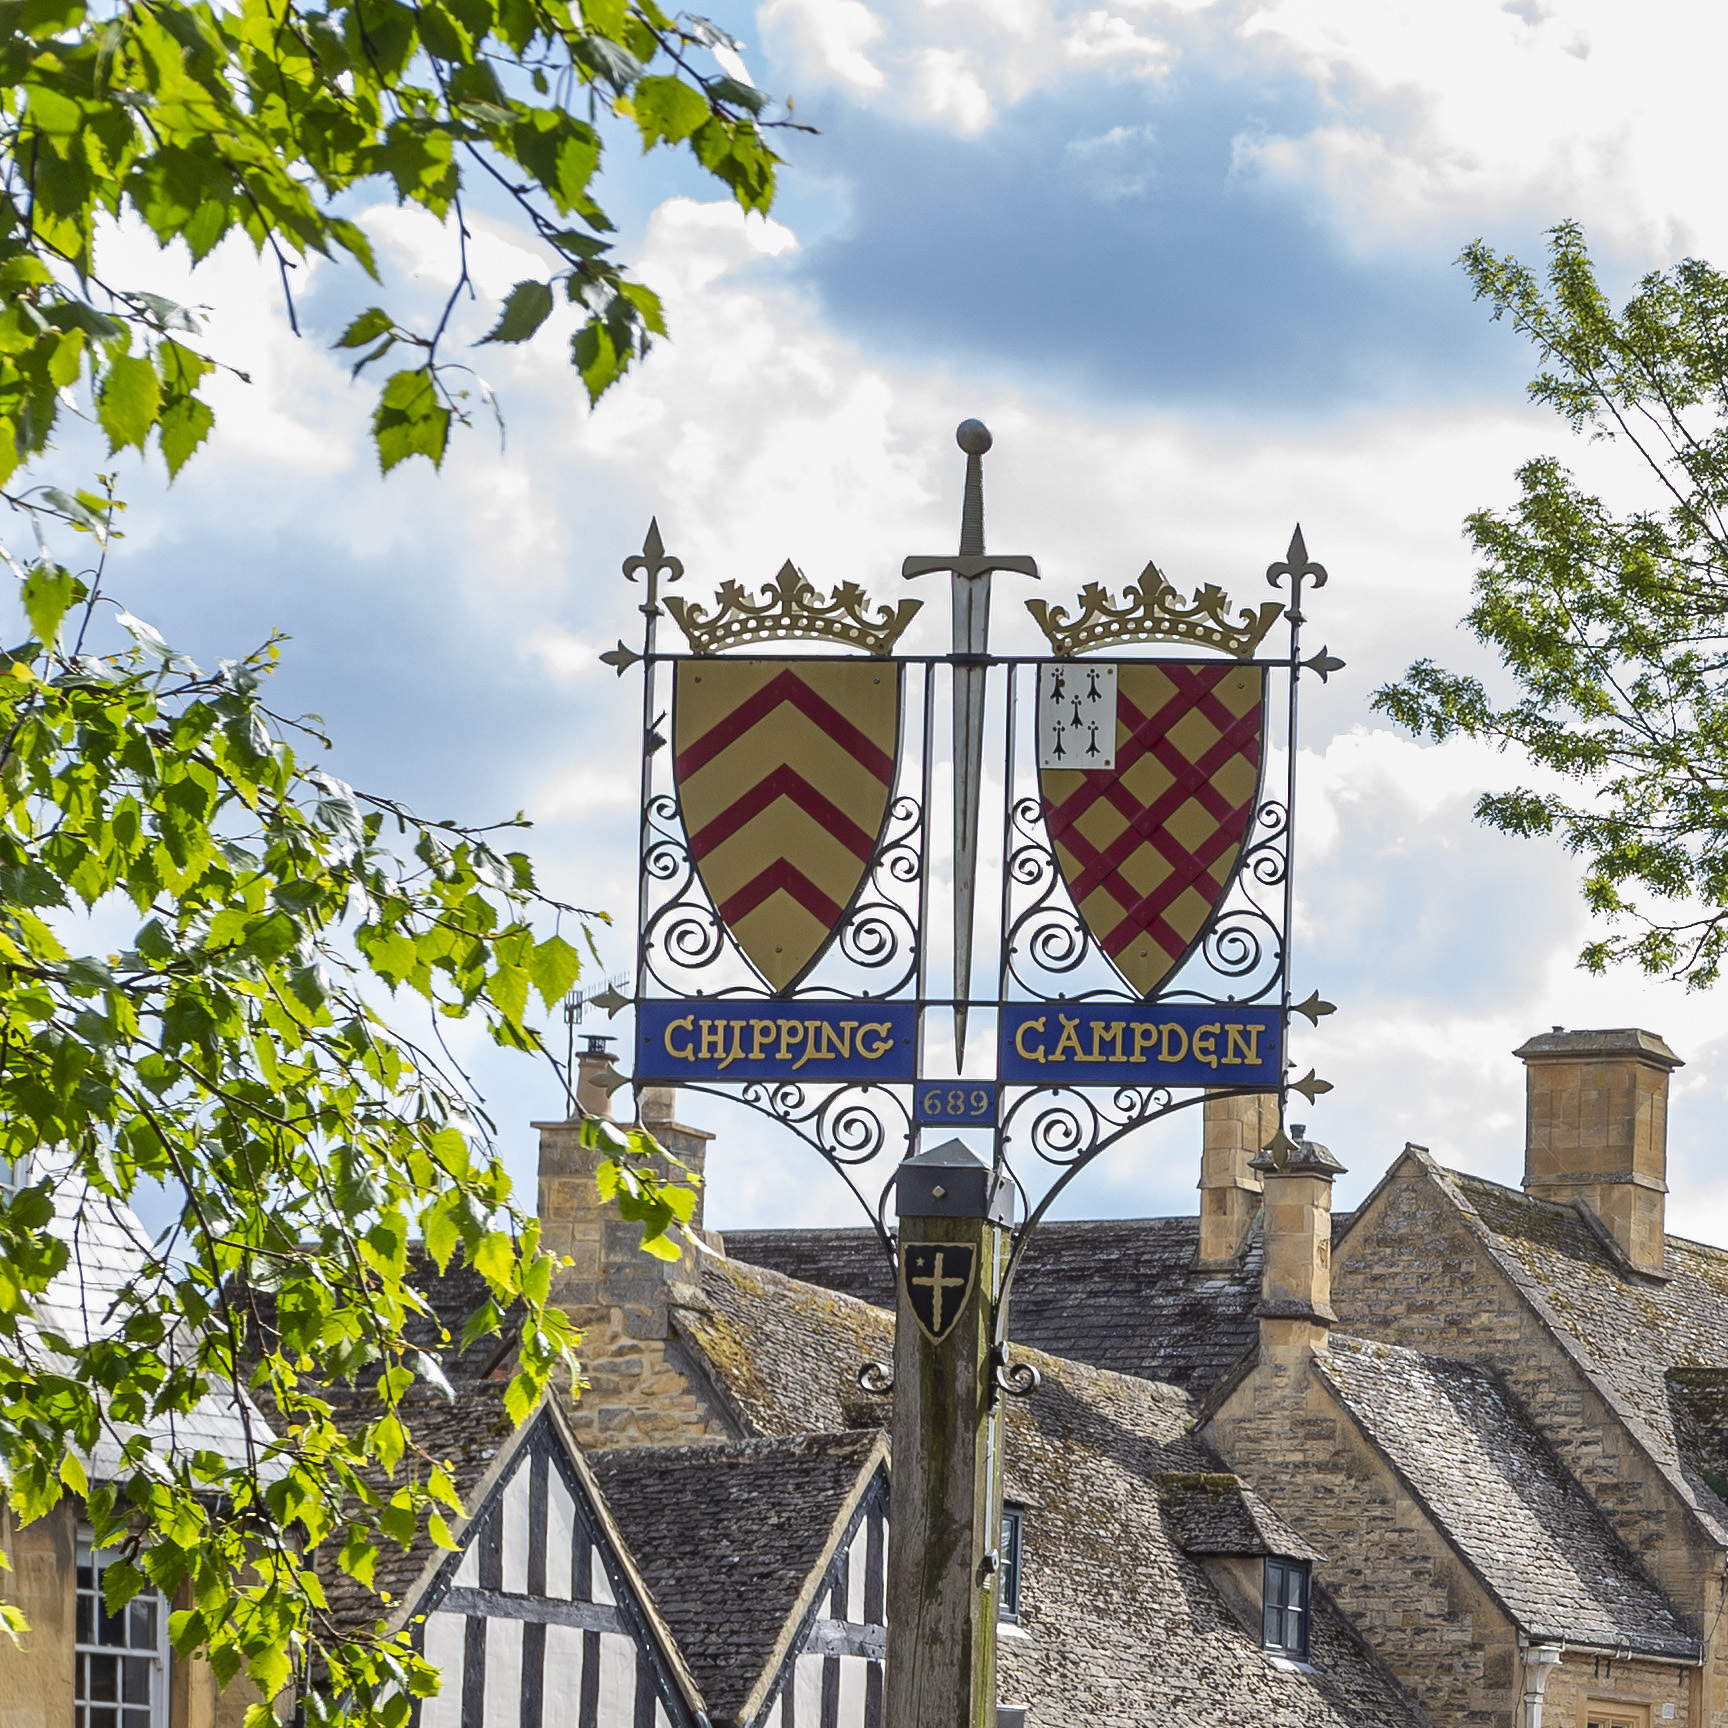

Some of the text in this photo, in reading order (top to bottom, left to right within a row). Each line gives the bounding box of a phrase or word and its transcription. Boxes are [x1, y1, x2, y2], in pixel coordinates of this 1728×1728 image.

[663, 1012, 1264, 1070] CHIPPING CAMPDEN
[924, 1090, 988, 1115] 689
